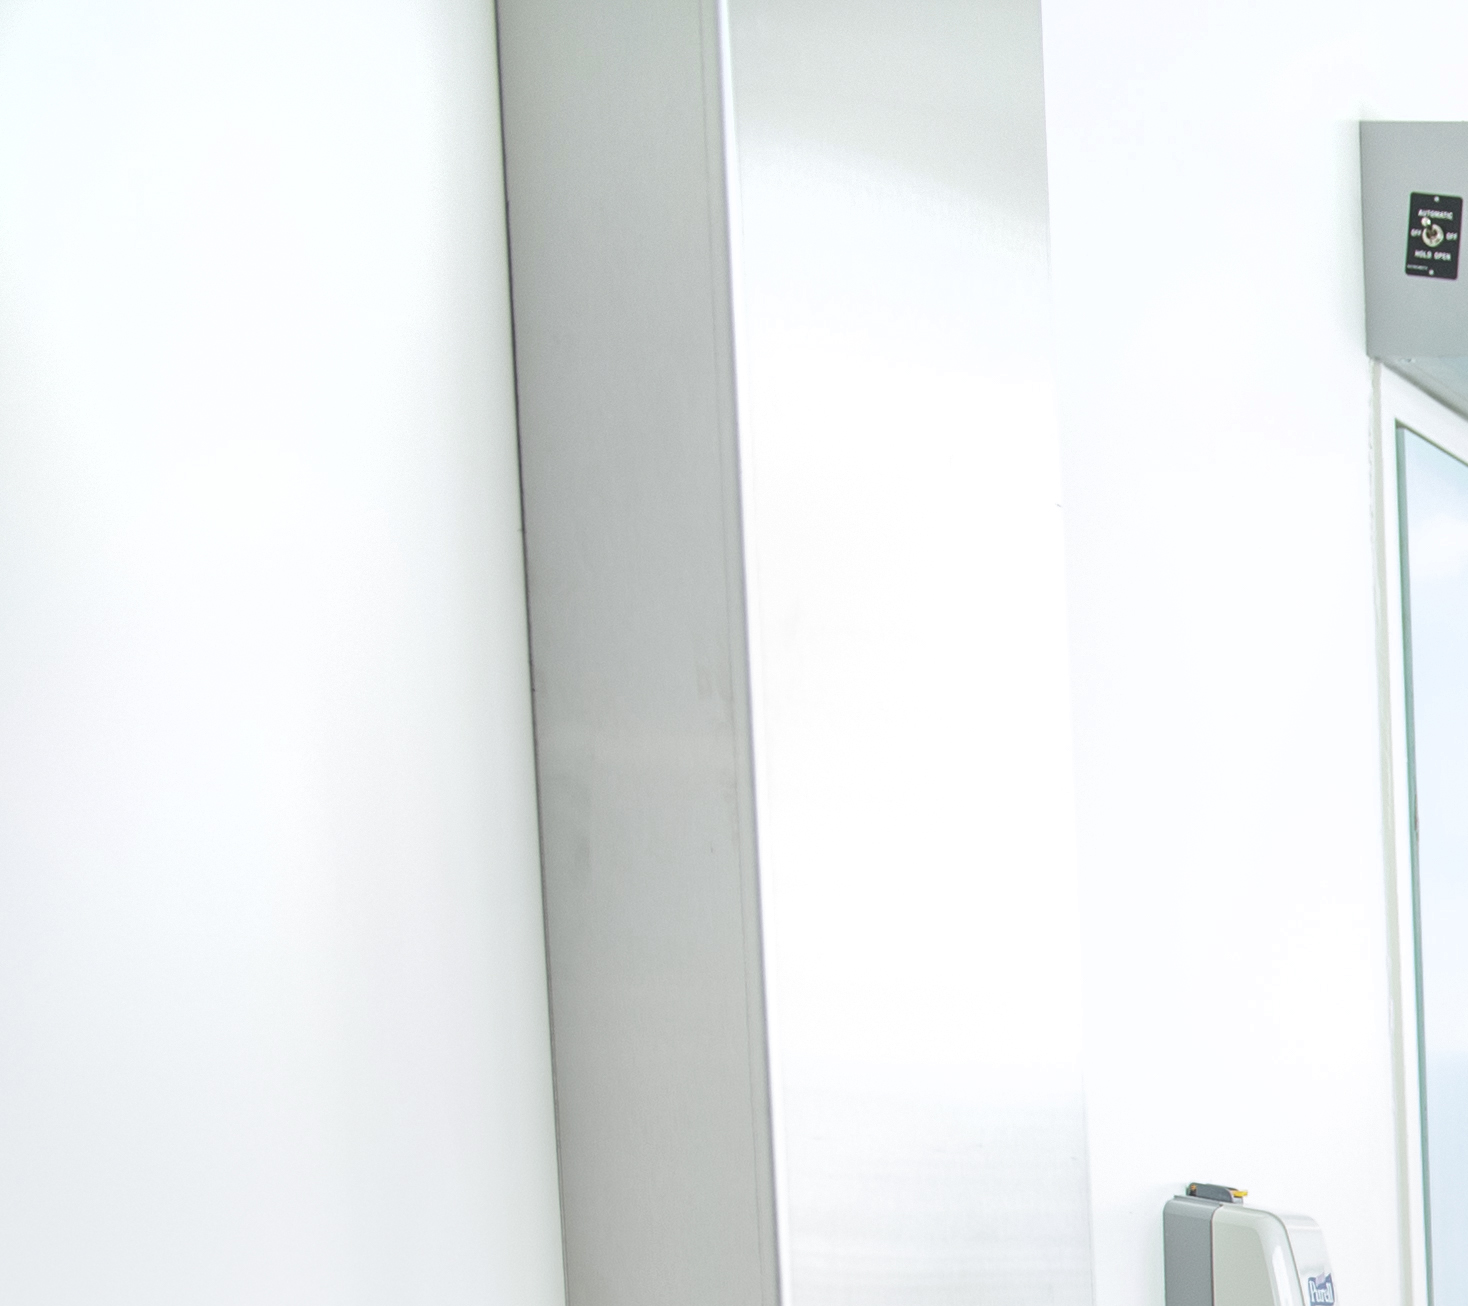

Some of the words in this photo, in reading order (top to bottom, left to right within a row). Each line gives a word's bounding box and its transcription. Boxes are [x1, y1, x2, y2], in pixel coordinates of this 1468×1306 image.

[1418, 209, 1453, 220] AUTOMATIC
[1411, 229, 1422, 237] OFF
[1446, 232, 1458, 240] OFF
[1414, 250, 1432, 259] HOLD
[1434, 251, 1451, 261] OPEN
[1309, 1280, 1334, 1303] Purell
